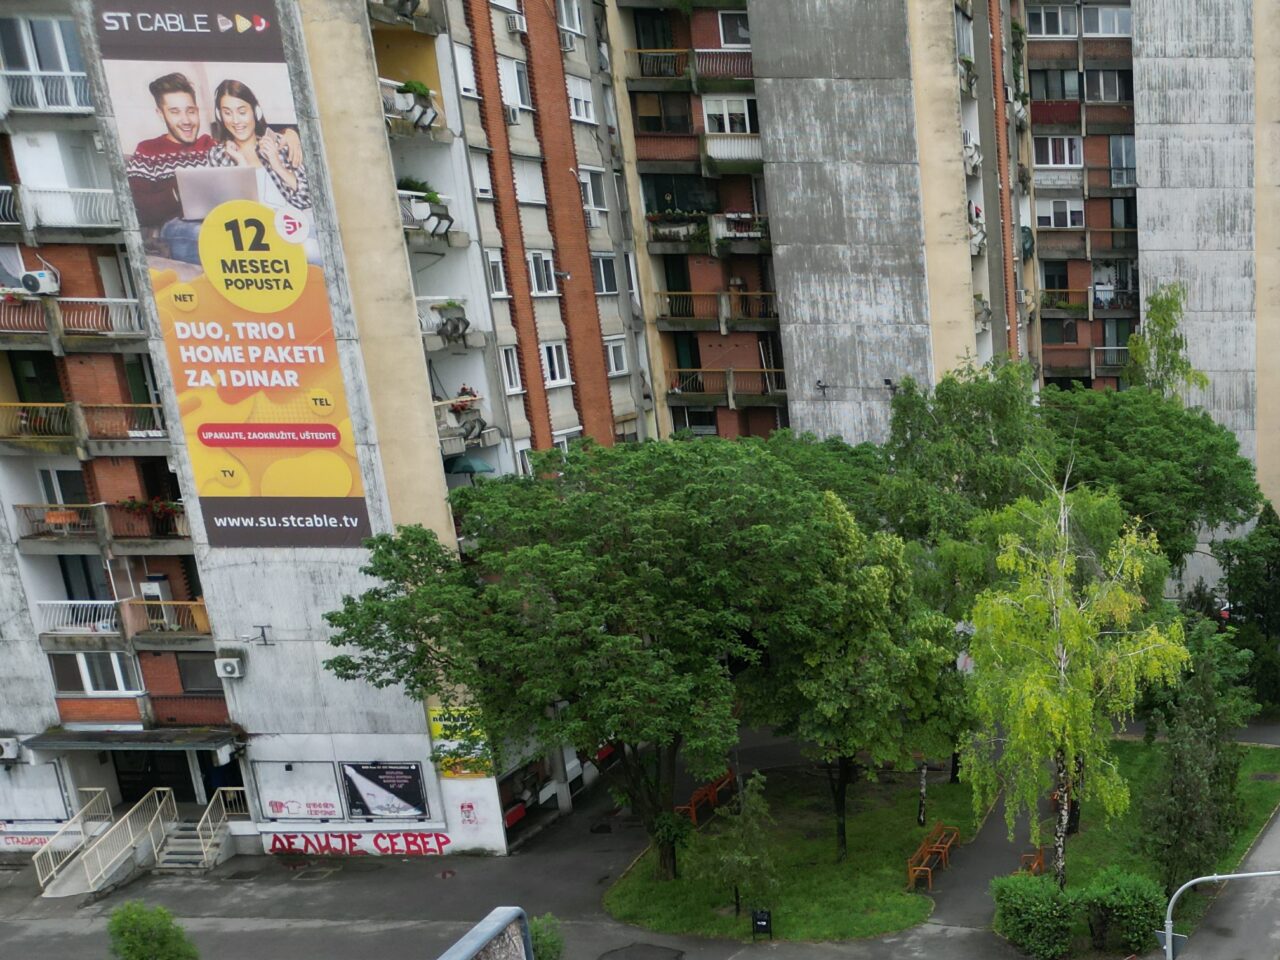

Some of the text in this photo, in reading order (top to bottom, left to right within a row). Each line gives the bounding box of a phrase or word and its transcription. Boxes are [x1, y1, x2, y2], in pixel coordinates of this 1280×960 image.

[102, 12, 211, 32] ST CABLE
[224, 218, 271, 252] 12
[221, 259, 290, 274] MESECI
[224, 278, 293, 291] POPUSTA
[174, 293, 194, 302] NET
[174, 321, 296, 342] DUO, TRIO I
[180, 345, 326, 364] HOME PAKETI
[185, 369, 300, 388] ZA 1 DINAR
[312, 397, 332, 407] TEL
[202, 430, 337, 440] UPAKUJTE, ZAOKRUŽITE, UŠTEDITE
[220, 469, 235, 478] TV
[214, 514, 359, 528] www.su.stcable.tv
[269, 832, 452, 856] ДЕЛИЈЕ СЕВЕР
